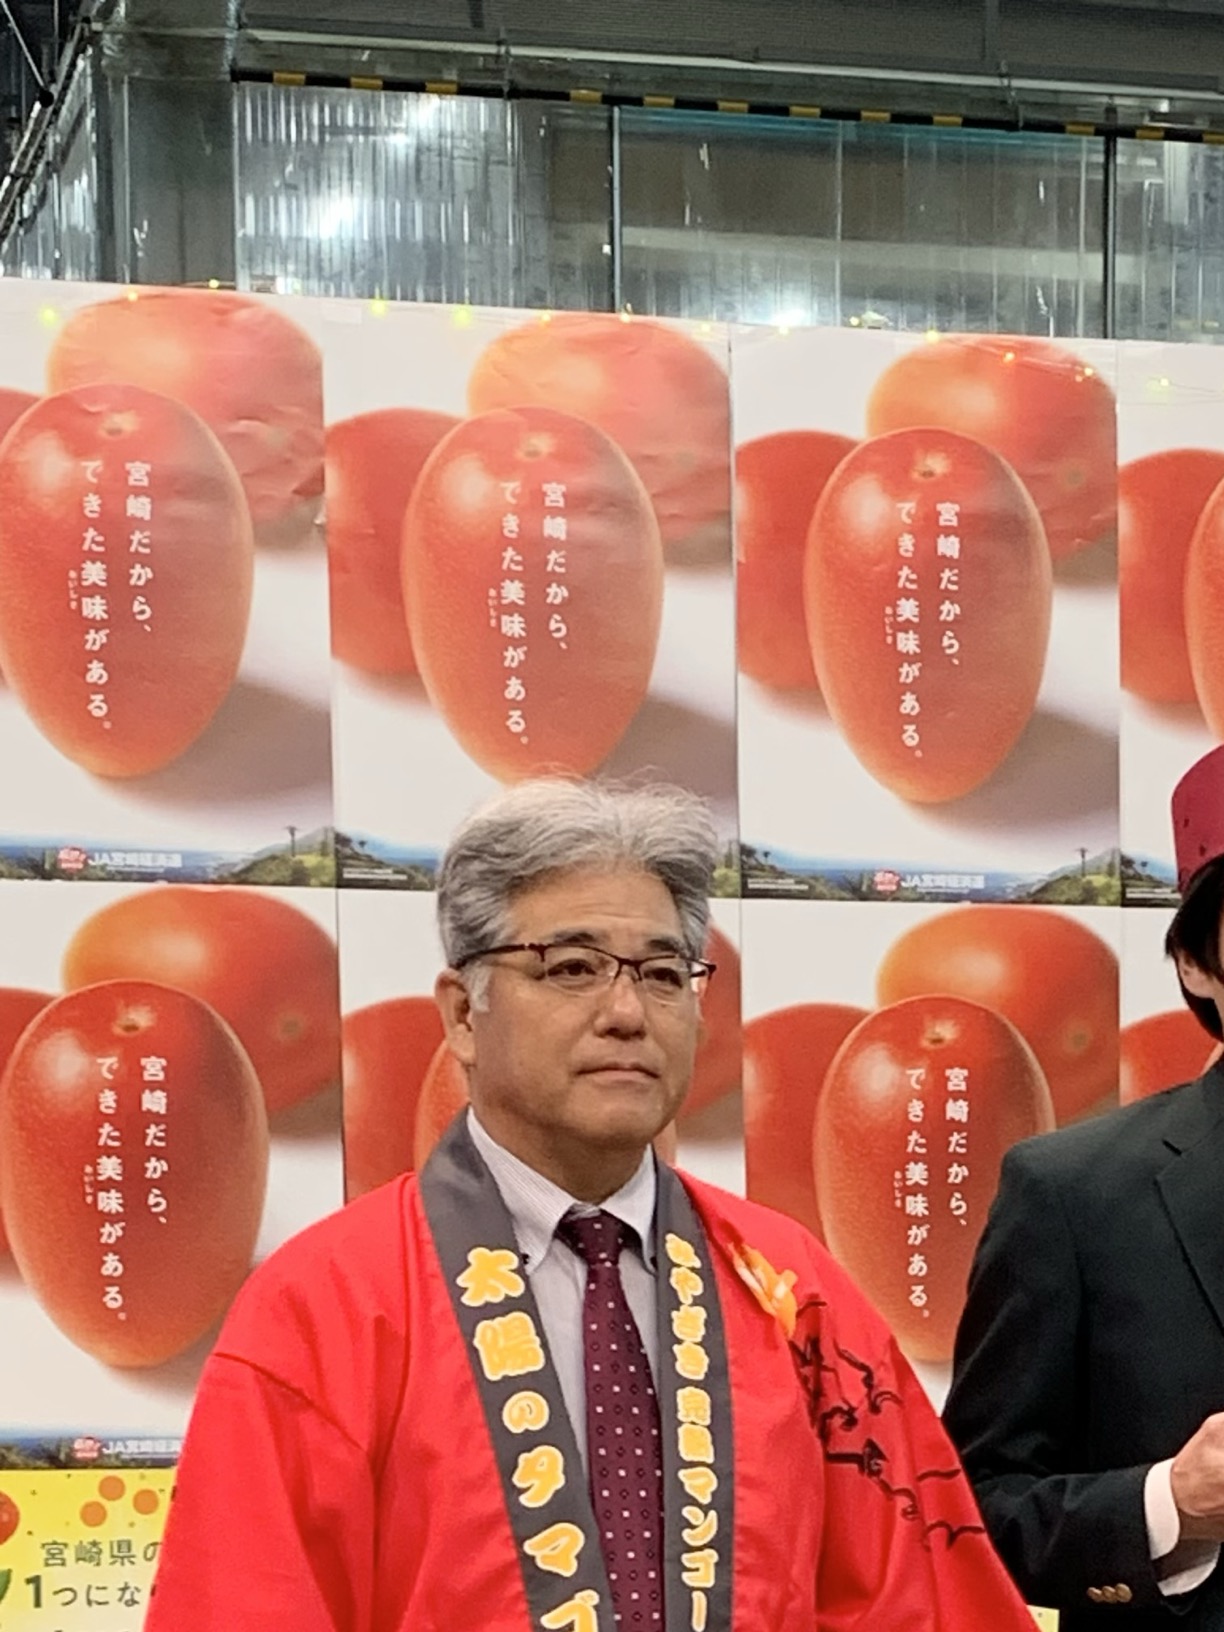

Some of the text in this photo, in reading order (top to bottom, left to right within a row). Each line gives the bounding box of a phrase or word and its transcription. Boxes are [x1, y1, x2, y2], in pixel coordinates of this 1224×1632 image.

[81, 460, 111, 728] できた美味がある。
[125, 461, 153, 631] 宮崎だから、
[501, 481, 528, 743] できた美味がある。
[542, 482, 569, 650] 宮崎だから、
[896, 501, 922, 757] できた美味がある。
[936, 501, 960, 665] 宮崎だから、
[96, 1056, 126, 1320] できた美味がある。
[140, 1056, 168, 1224] 宮崎だから、
[905, 1067, 930, 1317] できた美味がある。
[945, 1067, 969, 1226] 宮崎だから、
